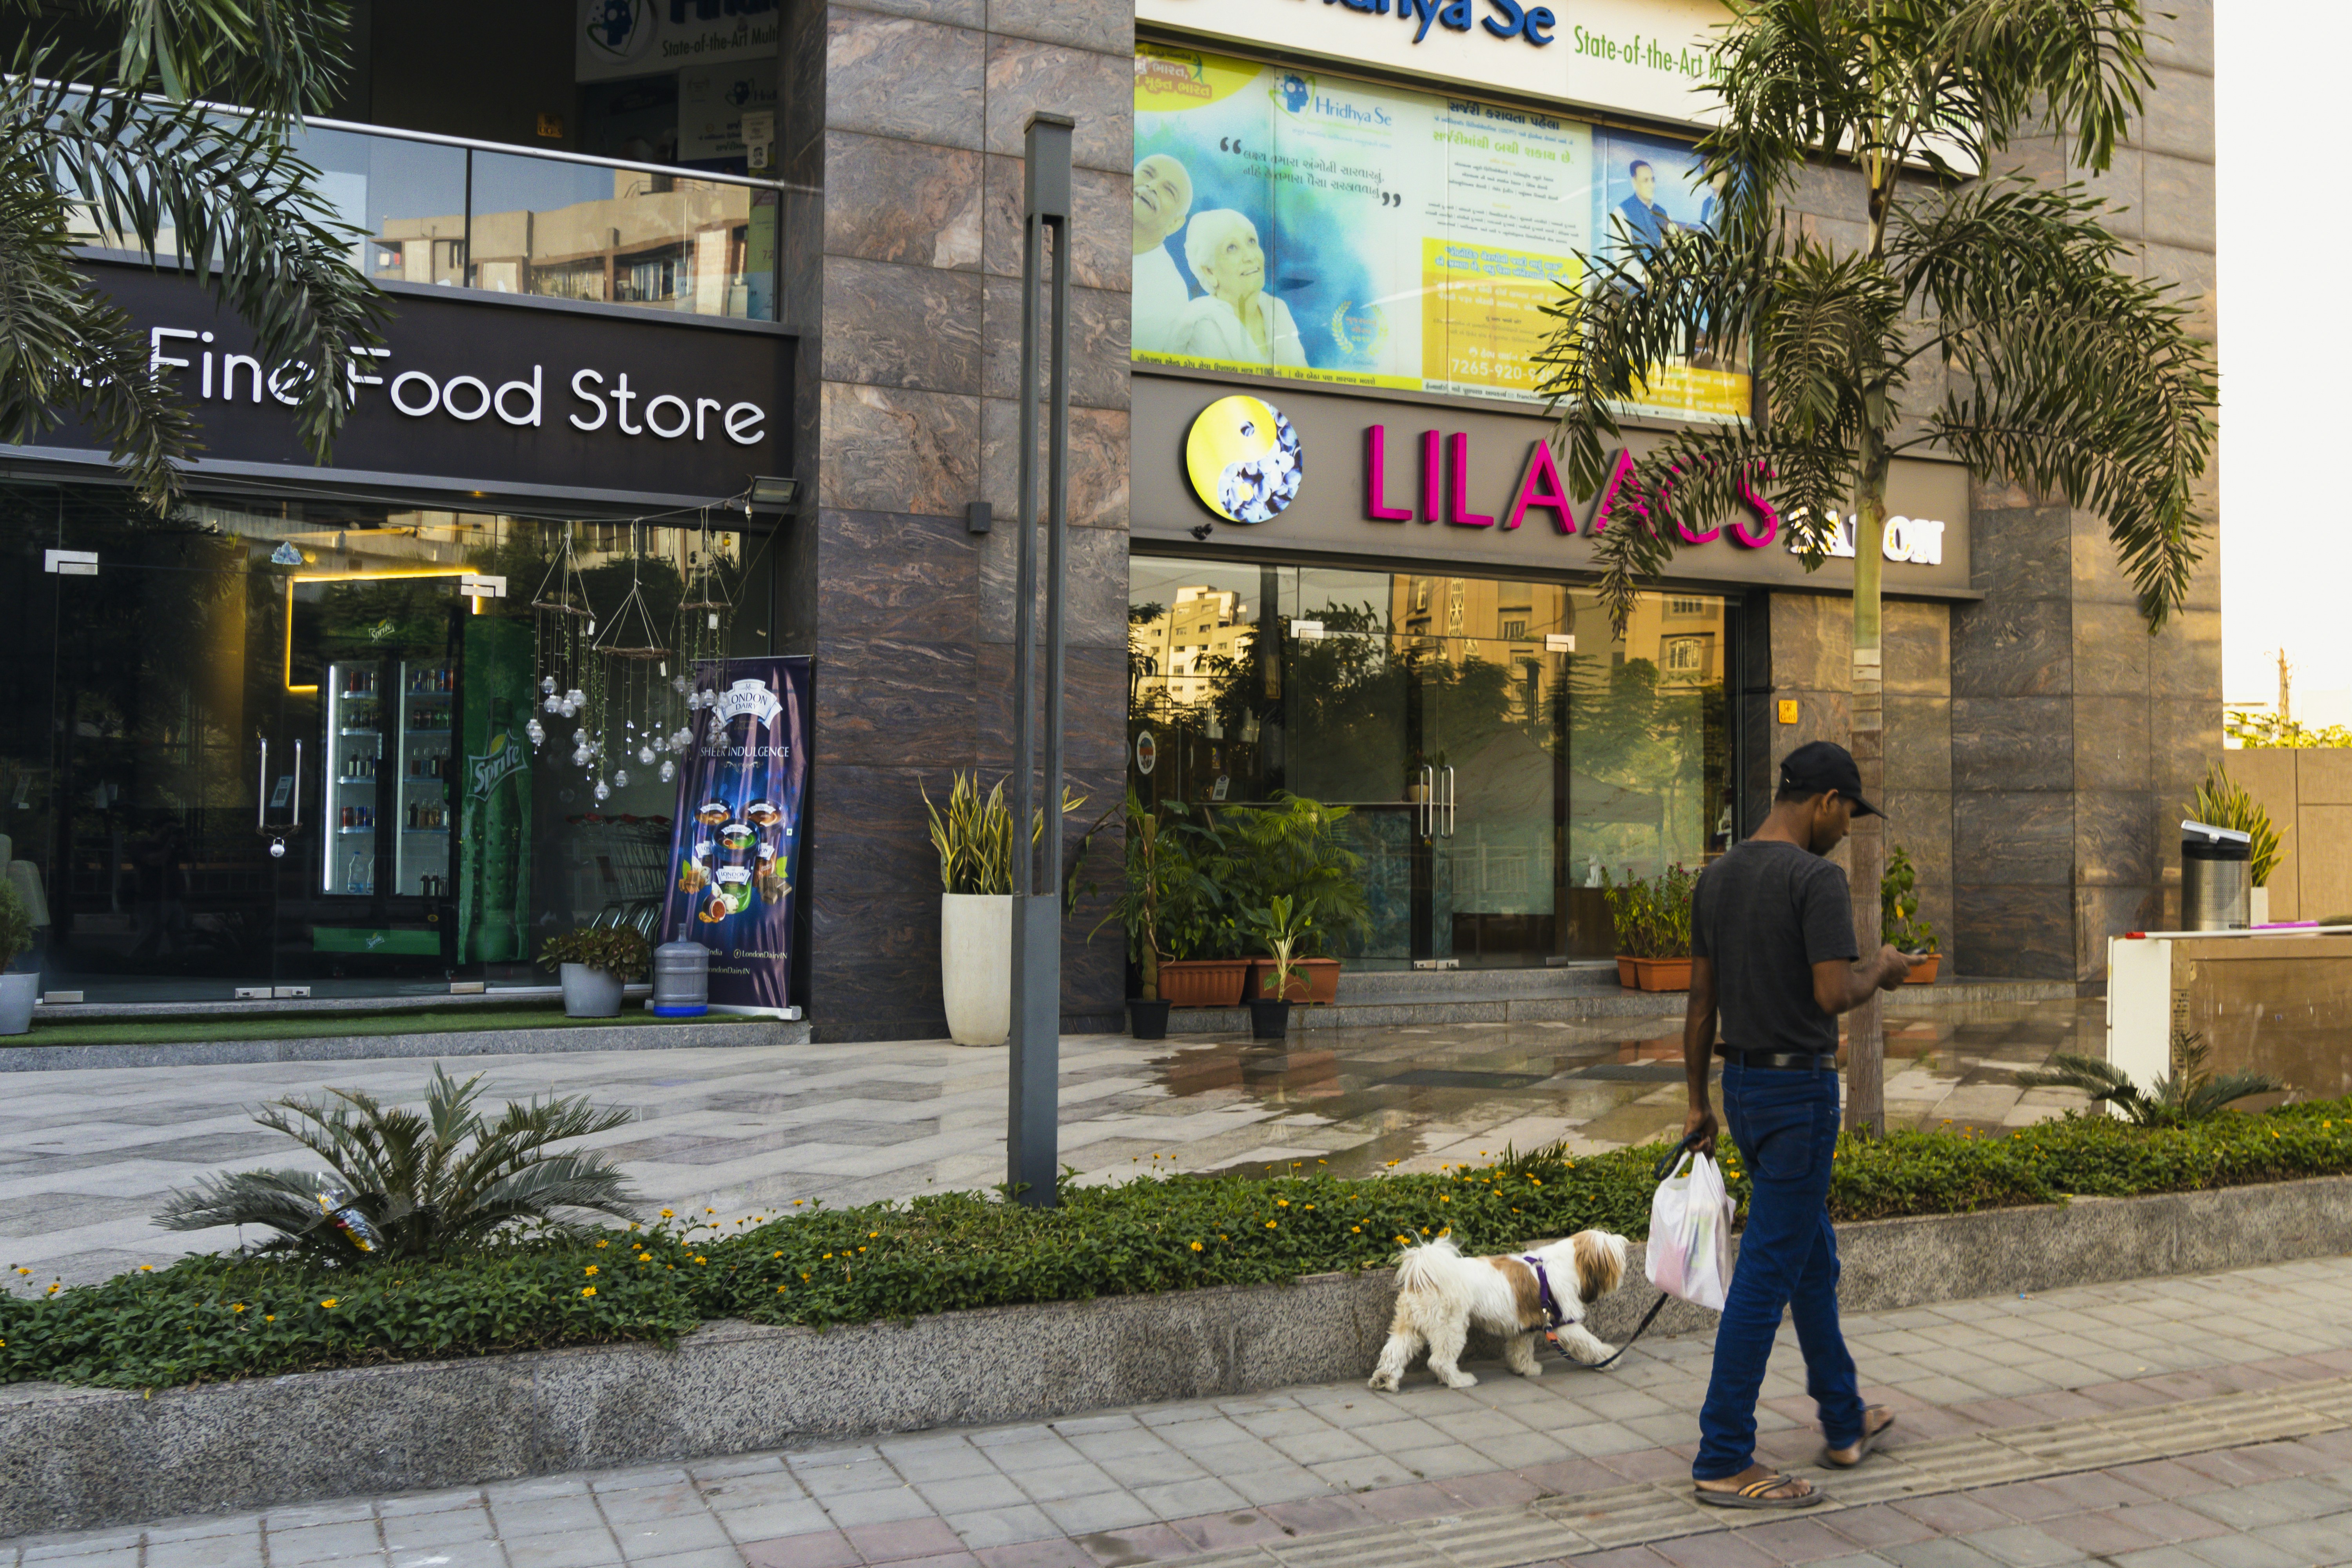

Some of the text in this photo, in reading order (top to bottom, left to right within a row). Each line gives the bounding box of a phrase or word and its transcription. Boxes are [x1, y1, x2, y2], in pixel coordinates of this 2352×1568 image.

[662, 31, 748, 57] State-of-the-Art
[1574, 25, 1702, 77] State-of-the-Art
[1178, 82, 1210, 96] ભારત
[1316, 96, 1371, 126] Hridhya
[1485, 109, 1525, 124] કરાવતા
[1452, 358, 1555, 383] 7265-920-920
[151, 327, 315, 406] Fine
[347, 346, 541, 426] Food
[569, 368, 766, 445] Store
[728, 693, 767, 706] ONDON
[728, 746, 789, 757] INDULGENCE
[474, 742, 520, 793] Sprite
[742, 950, 788, 960] LondonDairyIN
[708, 966, 750, 976] ondonDairyIN
